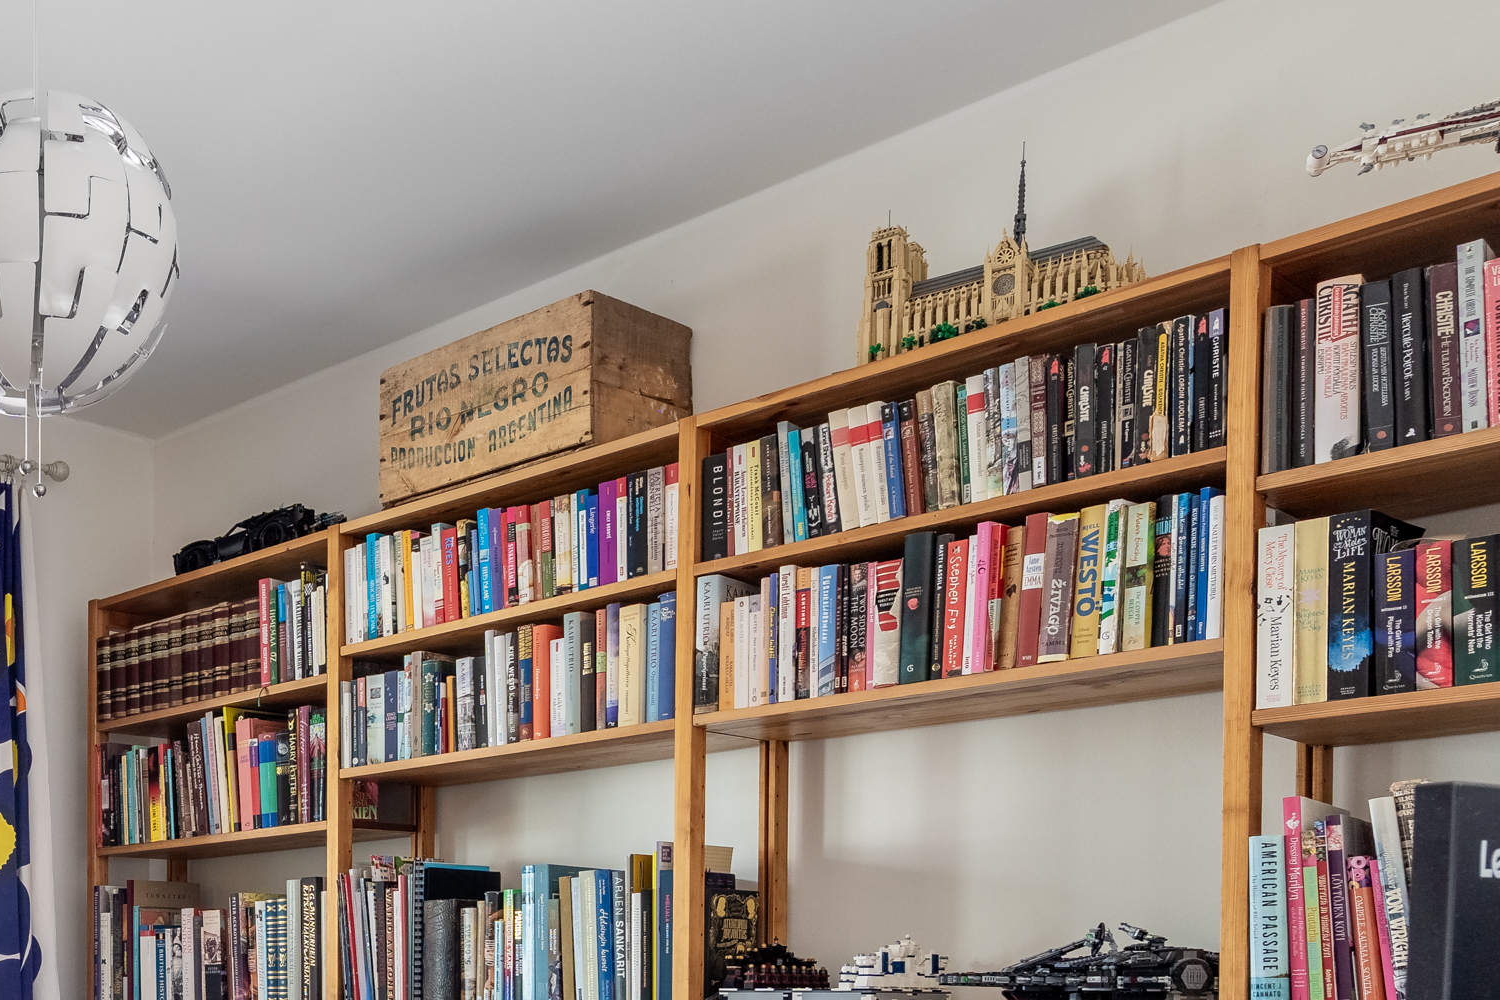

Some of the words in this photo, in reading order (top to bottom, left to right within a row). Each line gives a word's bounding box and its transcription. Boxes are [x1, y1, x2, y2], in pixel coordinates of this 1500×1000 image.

[1318, 284, 1332, 344] CHRISTIE
[1333, 284, 1359, 343] AGATHA
[1370, 307, 1379, 343] CHRISTIE
[390, 363, 461, 428] FRUTAS
[468, 334, 573, 382] SELECTAS
[1124, 373, 1133, 403] CHRISTIE
[1142, 369, 1153, 407] CHRISTIE
[410, 406, 451, 441] RIO
[461, 371, 549, 423] NEGRO
[1079, 385, 1090, 422] CHRISTIE
[390, 437, 476, 470] PRODUCCION
[489, 386, 573, 453] ARGENTINA
[713, 465, 723, 526] BLONDI
[445, 537, 453, 565] KEYES
[1130, 537, 1142, 562] Binchy
[1264, 541, 1275, 566] Mercy
[1278, 533, 1287, 548] The
[1336, 546, 1365, 560] LIFE
[782, 572, 790, 590] Torsti
[949, 556, 961, 604] Stephen
[1023, 575, 1042, 586] EMMA
[1077, 529, 1100, 616] WESTÖ
[1265, 566, 1276, 589] Close
[1276, 551, 1287, 581] Mystery
[1387, 556, 1402, 602] LARSSON
[1426, 547, 1441, 593] LARSSON
[1471, 541, 1487, 589] LARSSON
[1277, 582, 1287, 590] of
[1343, 561, 1355, 614] MARIAN
[781, 593, 790, 619] Lehtinen
[947, 609, 958, 629] Fry
[703, 614, 711, 643] UTRIO
[850, 617, 858, 648] MOON
[859, 635, 866, 648] OF
[1270, 616, 1282, 658] Marian
[1342, 618, 1354, 660] KEYES
[1268, 660, 1282, 691] Keyes
[288, 734, 296, 762] HARRY
[289, 765, 297, 796] POTTER
[1289, 837, 1300, 865] Dressing
[1261, 843, 1277, 907] AMERICAN
[1288, 867, 1303, 900] Marilyn
[615, 877, 623, 915] ARJEN
[1332, 874, 1344, 918] LÖYTÖJEN
[1386, 888, 1404, 913] VON
[599, 909, 608, 946] Helsingin
[1262, 916, 1278, 970] PASSAGE
[1334, 921, 1345, 940] KOTI
[1388, 916, 1408, 967] WRIGHT
[601, 949, 609, 972] kasvit
[616, 920, 625, 978] SANKARIT
[1355, 896, 1363, 927] OMPELE,
[1359, 931, 1367, 963] SAUMAA,
[1363, 967, 1371, 995] SOVITA
[1252, 989, 1281, 998] CANNATO
